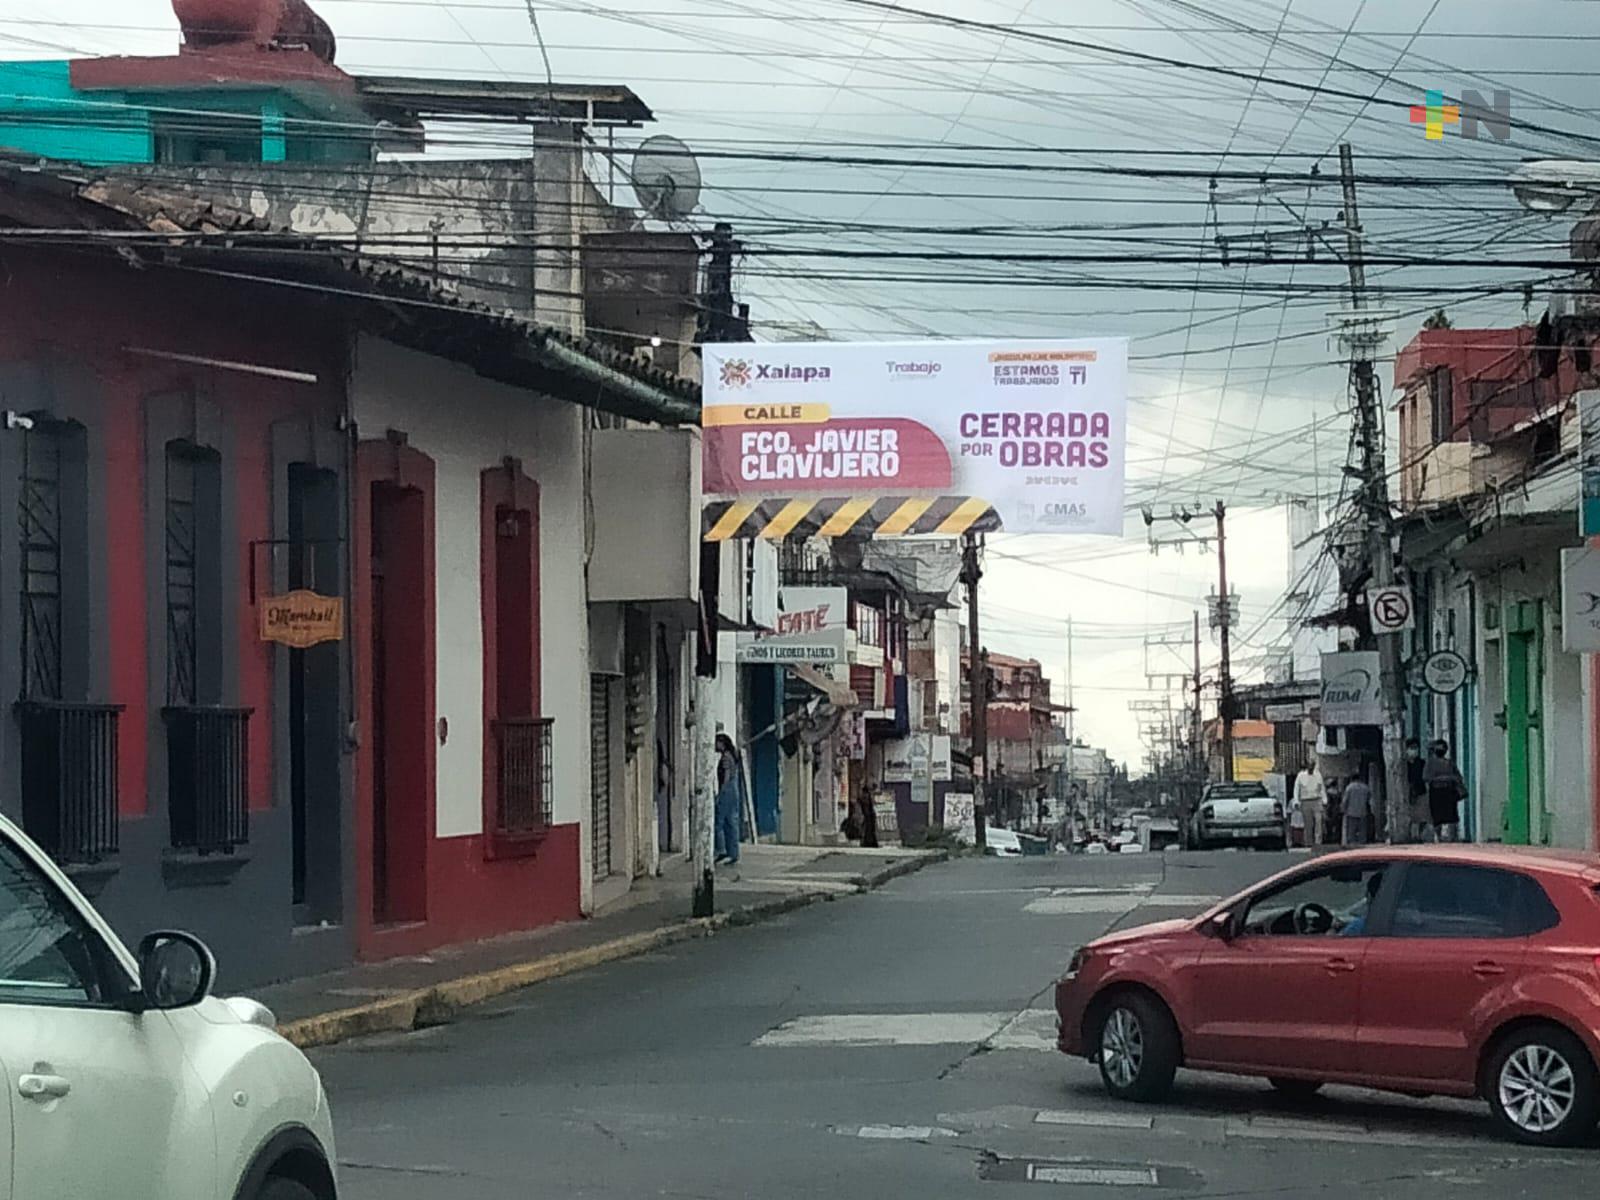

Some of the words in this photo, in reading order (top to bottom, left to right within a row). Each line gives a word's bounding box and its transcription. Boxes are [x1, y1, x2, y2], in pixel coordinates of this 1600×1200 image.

[755, 364, 831, 382] Xalapa
[886, 361, 942, 375] Trabajo
[994, 365, 1059, 376] ESTAMOS
[743, 406, 802, 420] CALLE
[960, 412, 1110, 438] CERRADA
[741, 431, 797, 455] FCO.
[805, 429, 899, 453] JAVIER
[961, 443, 993, 456] POR
[1000, 441, 1109, 468] OBRAS
[741, 452, 900, 481] CLAVIJERO
[1044, 503, 1087, 516] CMAS
